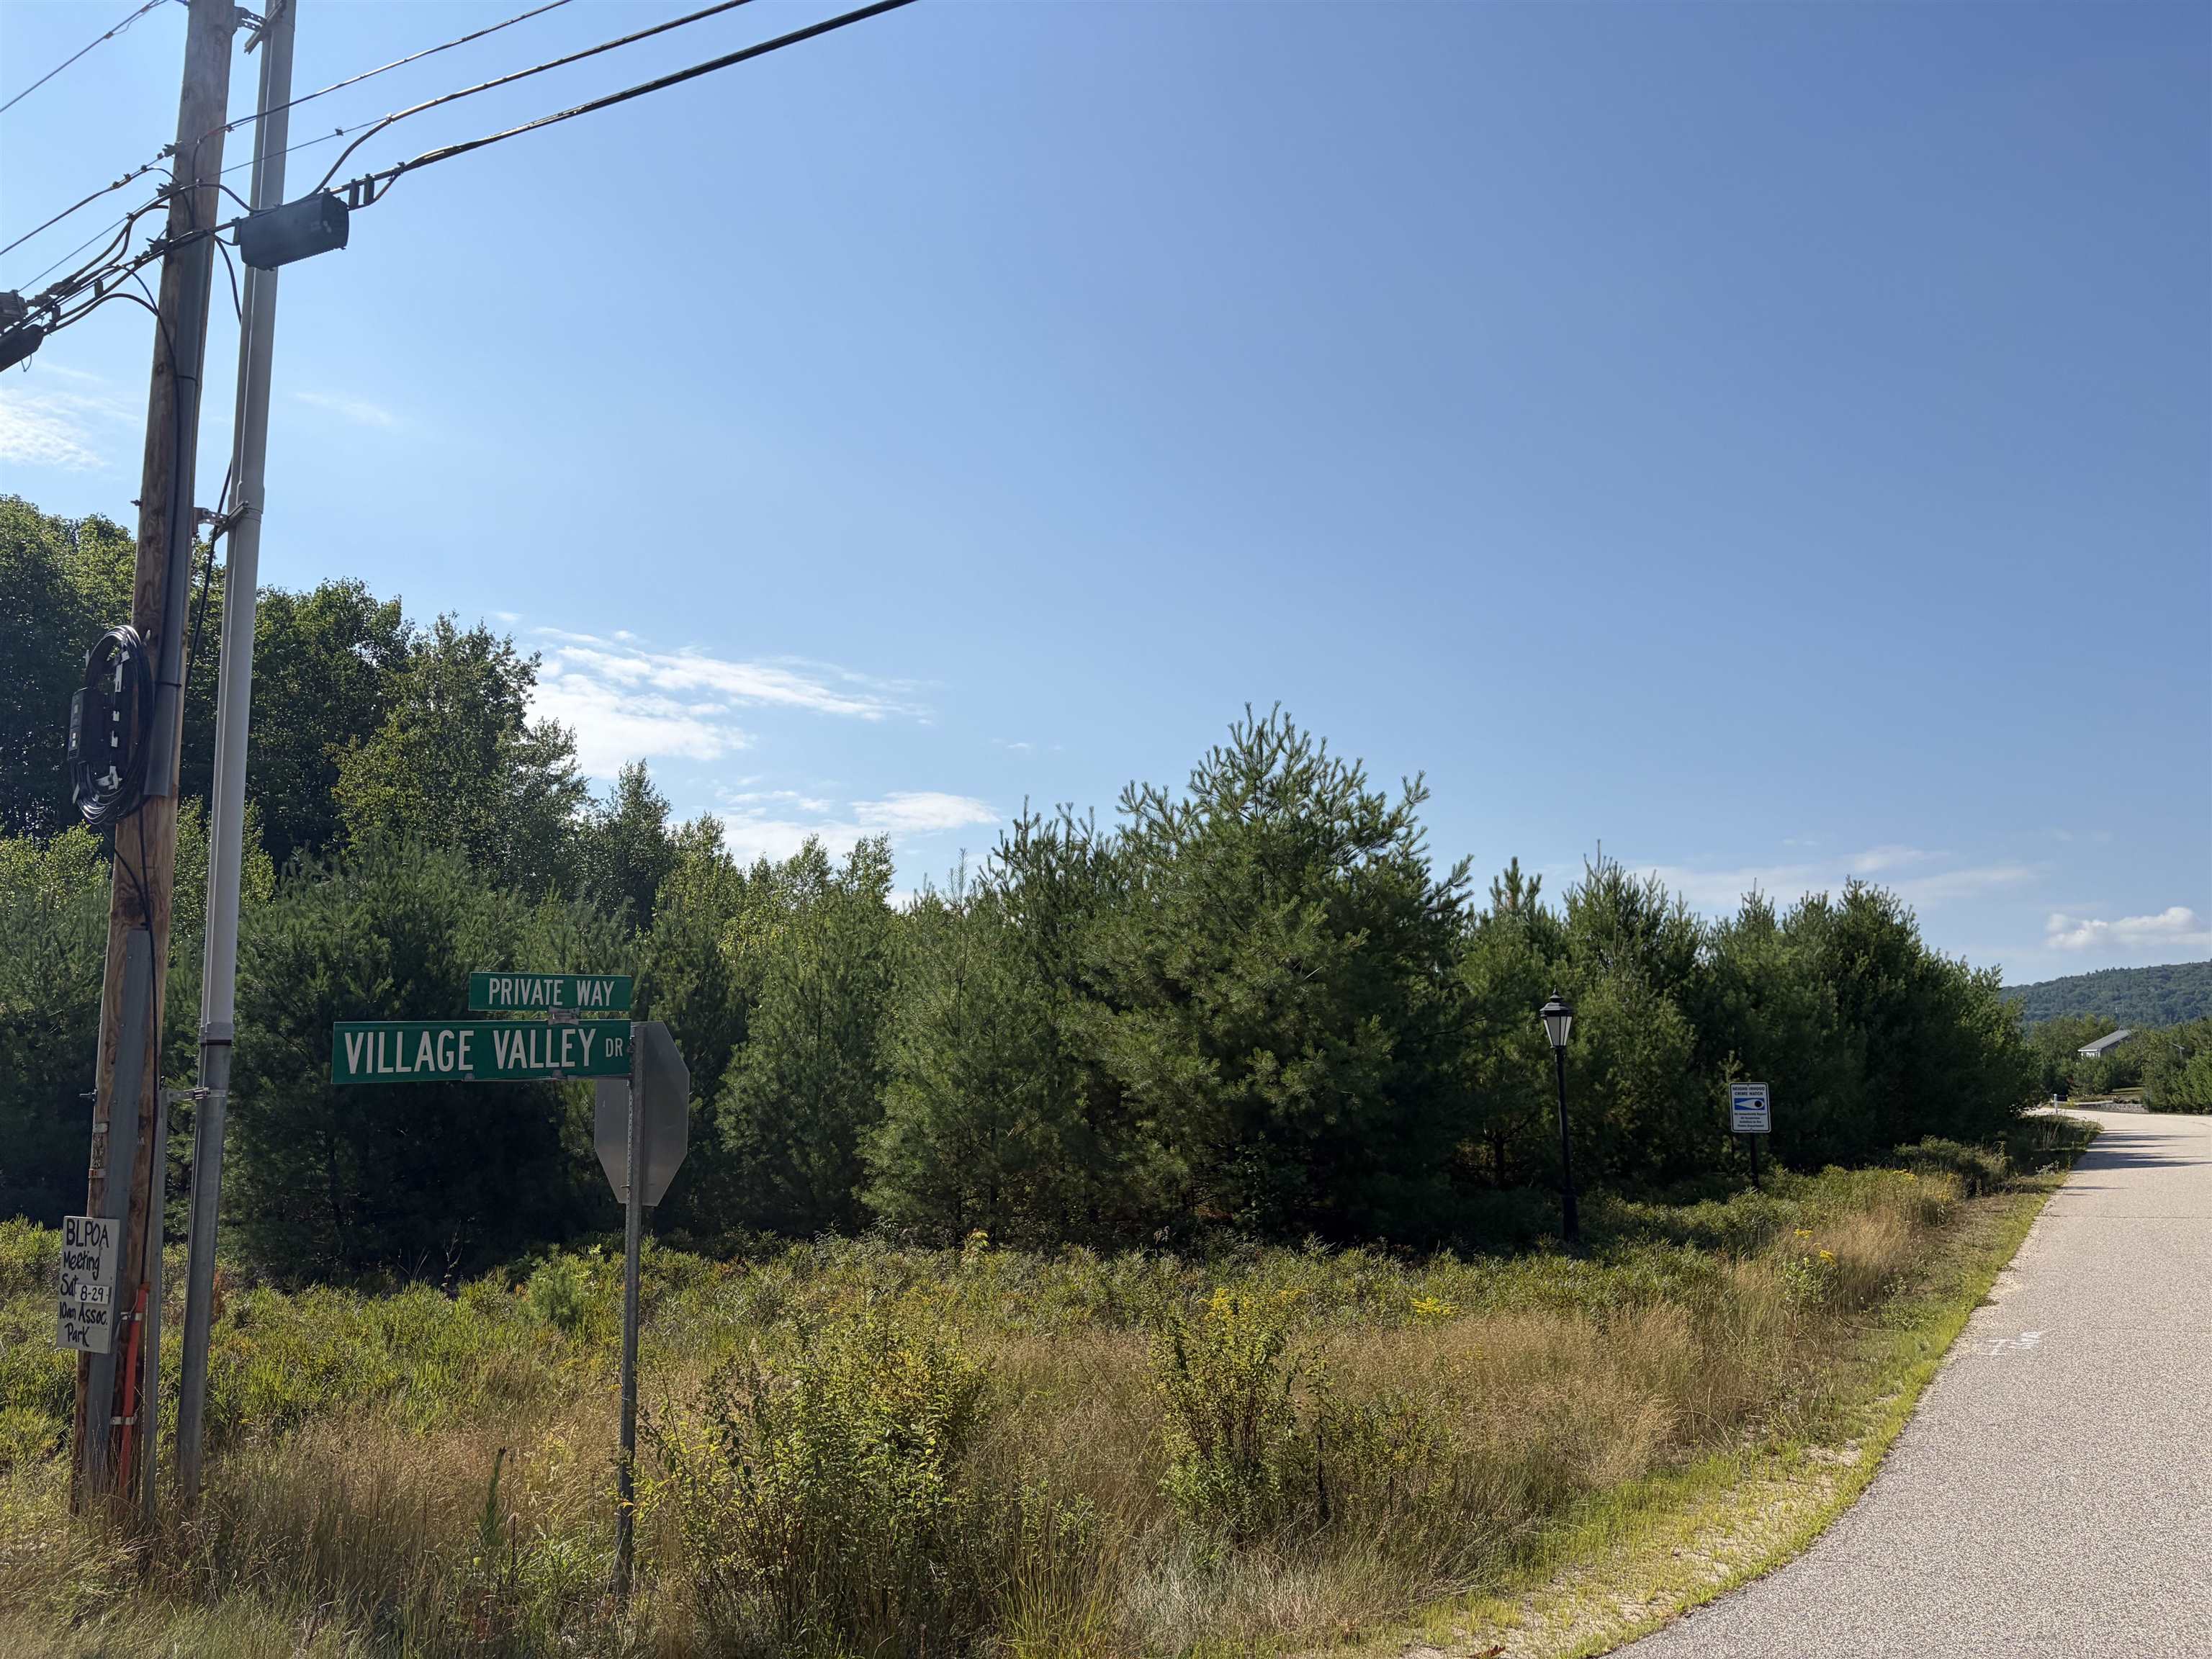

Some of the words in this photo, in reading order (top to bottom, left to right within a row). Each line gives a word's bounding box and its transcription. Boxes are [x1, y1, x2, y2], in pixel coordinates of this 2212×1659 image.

[489, 978, 564, 1006] PRIVATE
[577, 980, 616, 1007] WAY
[345, 1030, 475, 1075] VILLAGE
[493, 1028, 596, 1070] VALLEY
[606, 1037, 623, 1058] DR
[66, 1218, 109, 1248] BLPOA
[63, 1250, 101, 1280] Meeting
[60, 1273, 78, 1297] Sat
[81, 1285, 104, 1302] 8-29
[78, 1302, 108, 1325] Assoc.
